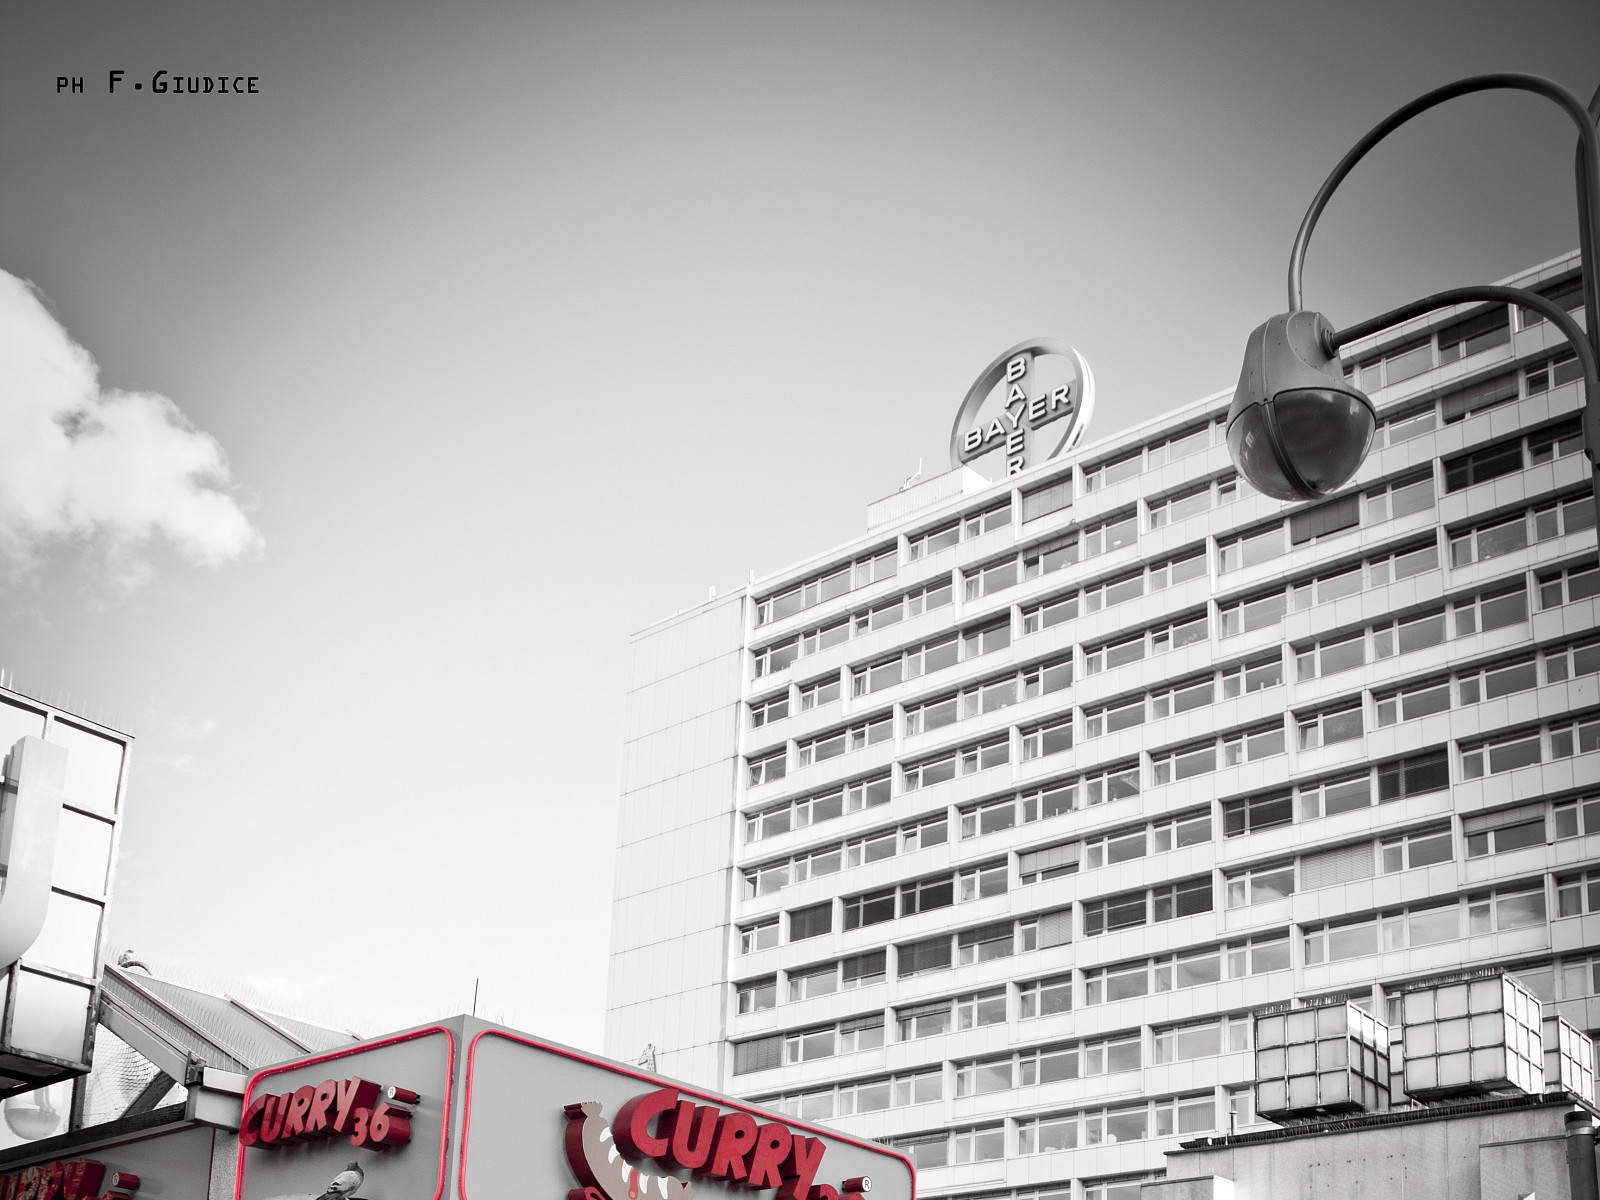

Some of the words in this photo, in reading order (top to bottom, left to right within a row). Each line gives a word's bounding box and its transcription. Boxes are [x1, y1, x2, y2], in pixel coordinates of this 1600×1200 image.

[963, 384, 1070, 453] BAYER
[1004, 356, 1027, 477] BAYER
[239, 1076, 366, 1148] CURRY
[351, 1102, 398, 1148] 36
